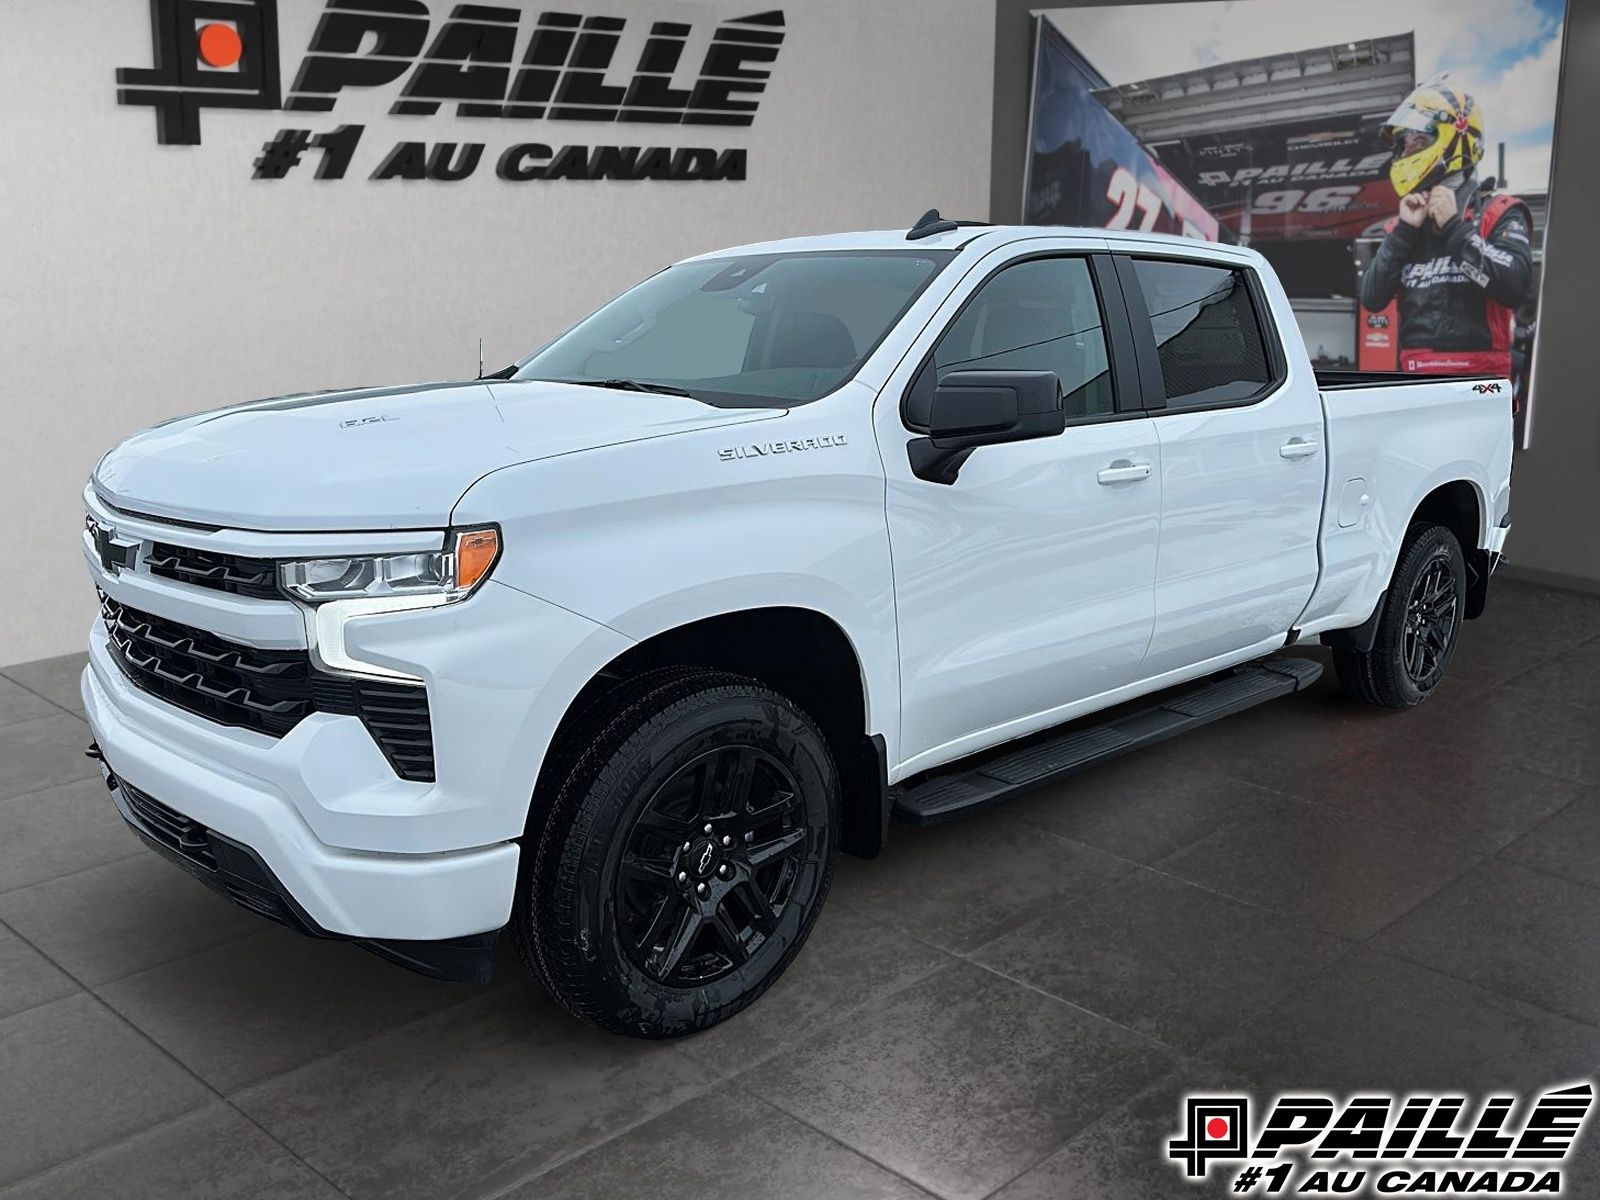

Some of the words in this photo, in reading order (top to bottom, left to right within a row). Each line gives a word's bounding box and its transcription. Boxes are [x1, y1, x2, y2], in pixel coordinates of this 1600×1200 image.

[282, 0, 785, 126] PAILLÉ
[252, 125, 365, 180] #1
[369, 142, 485, 180] AU
[496, 143, 747, 181] CANADA
[1290, 169, 1380, 182] CANADA
[1250, 185, 1362, 214] 96
[717, 435, 848, 461] SILVERADO
